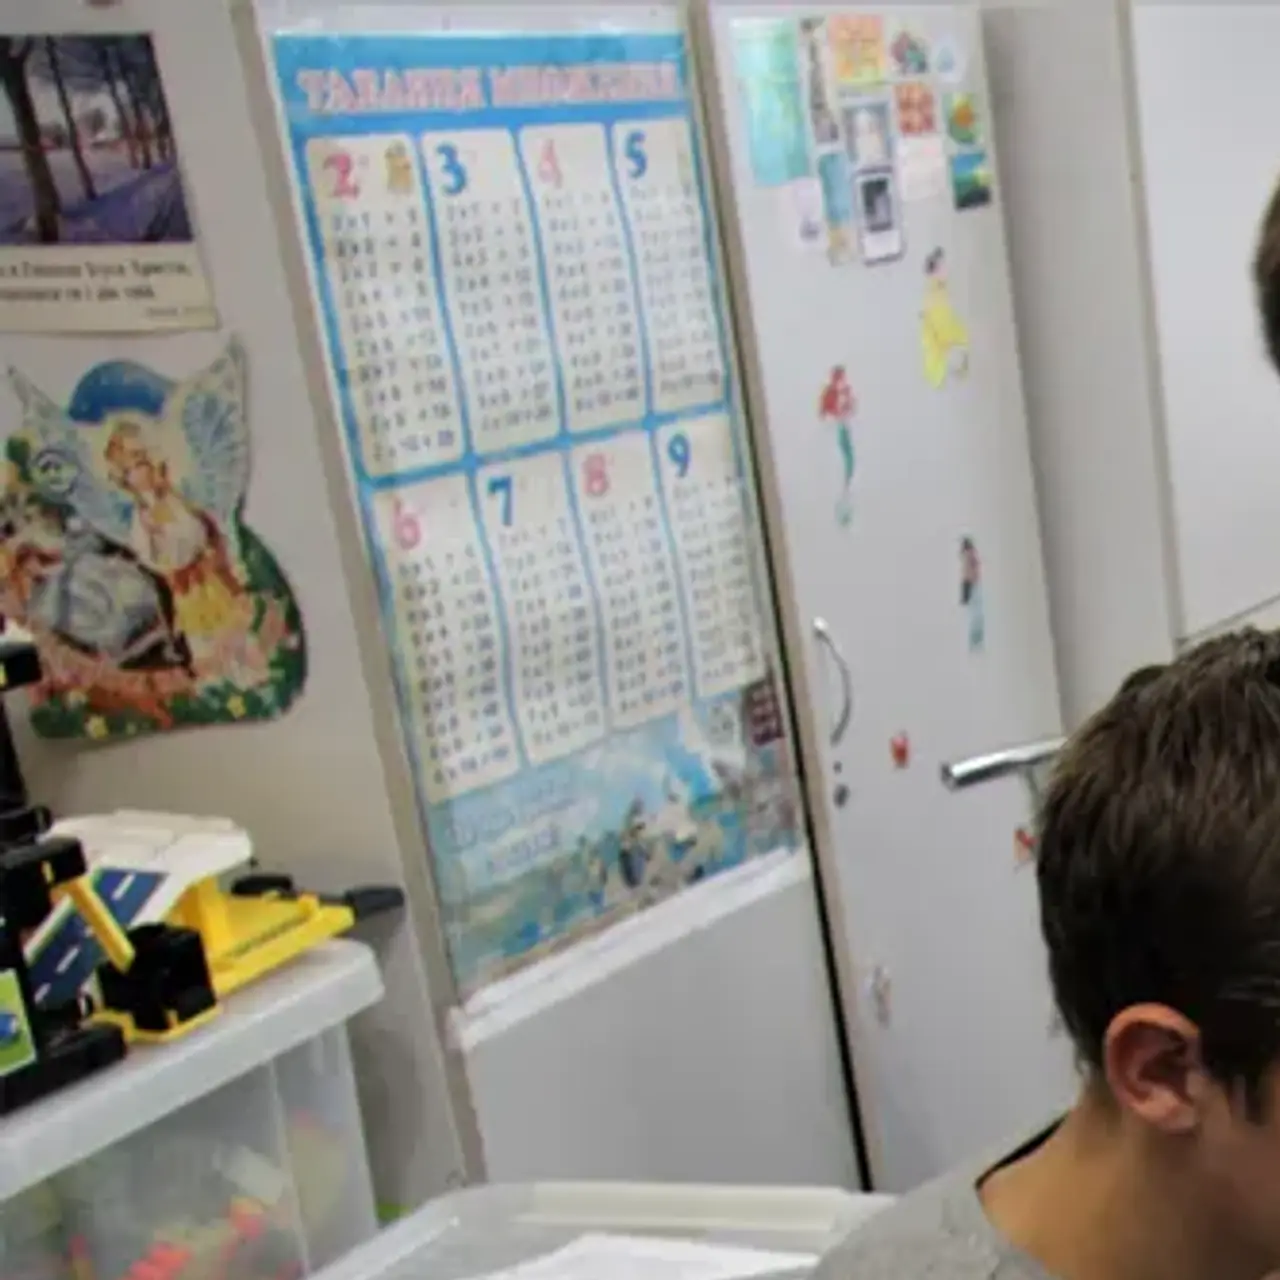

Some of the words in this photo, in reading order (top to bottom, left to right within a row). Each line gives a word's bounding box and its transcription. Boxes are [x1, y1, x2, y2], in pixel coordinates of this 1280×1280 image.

[323, 153, 360, 199] 2
[436, 142, 467, 196] 3
[624, 131, 647, 179] 5
[392, 497, 422, 551] 6
[486, 475, 514, 526] 7
[583, 453, 610, 497] 8
[667, 434, 690, 479] 9
